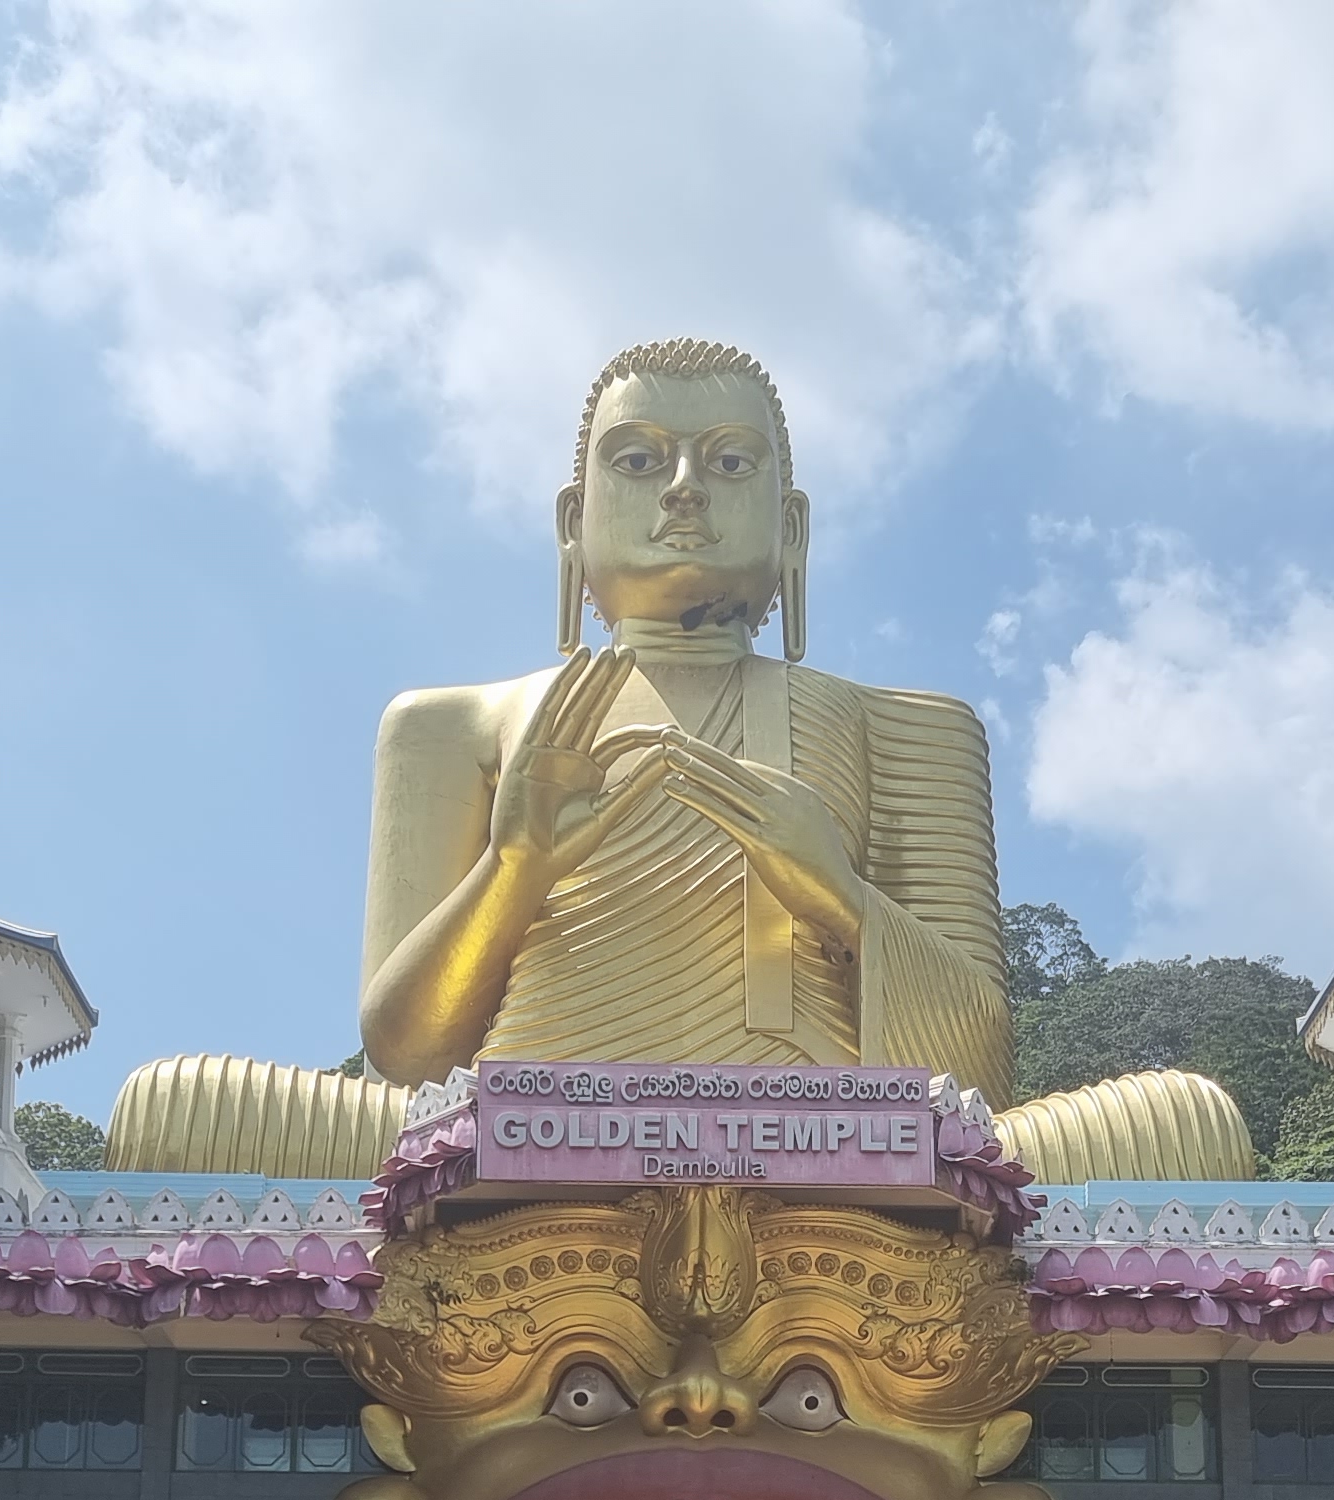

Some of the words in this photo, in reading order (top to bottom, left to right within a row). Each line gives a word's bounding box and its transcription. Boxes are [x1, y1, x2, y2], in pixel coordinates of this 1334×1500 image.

[487, 1067, 555, 1095] රංගිරි
[560, 1069, 614, 1103] දඹුලු
[620, 1069, 743, 1102] උයන්වත්ත
[747, 1073, 833, 1100] රජමහා
[837, 1072, 923, 1102] විහාරය
[493, 1112, 700, 1151] GOLDEN
[716, 1115, 919, 1153] TEMPLE
[642, 1153, 767, 1178] Dambulla
